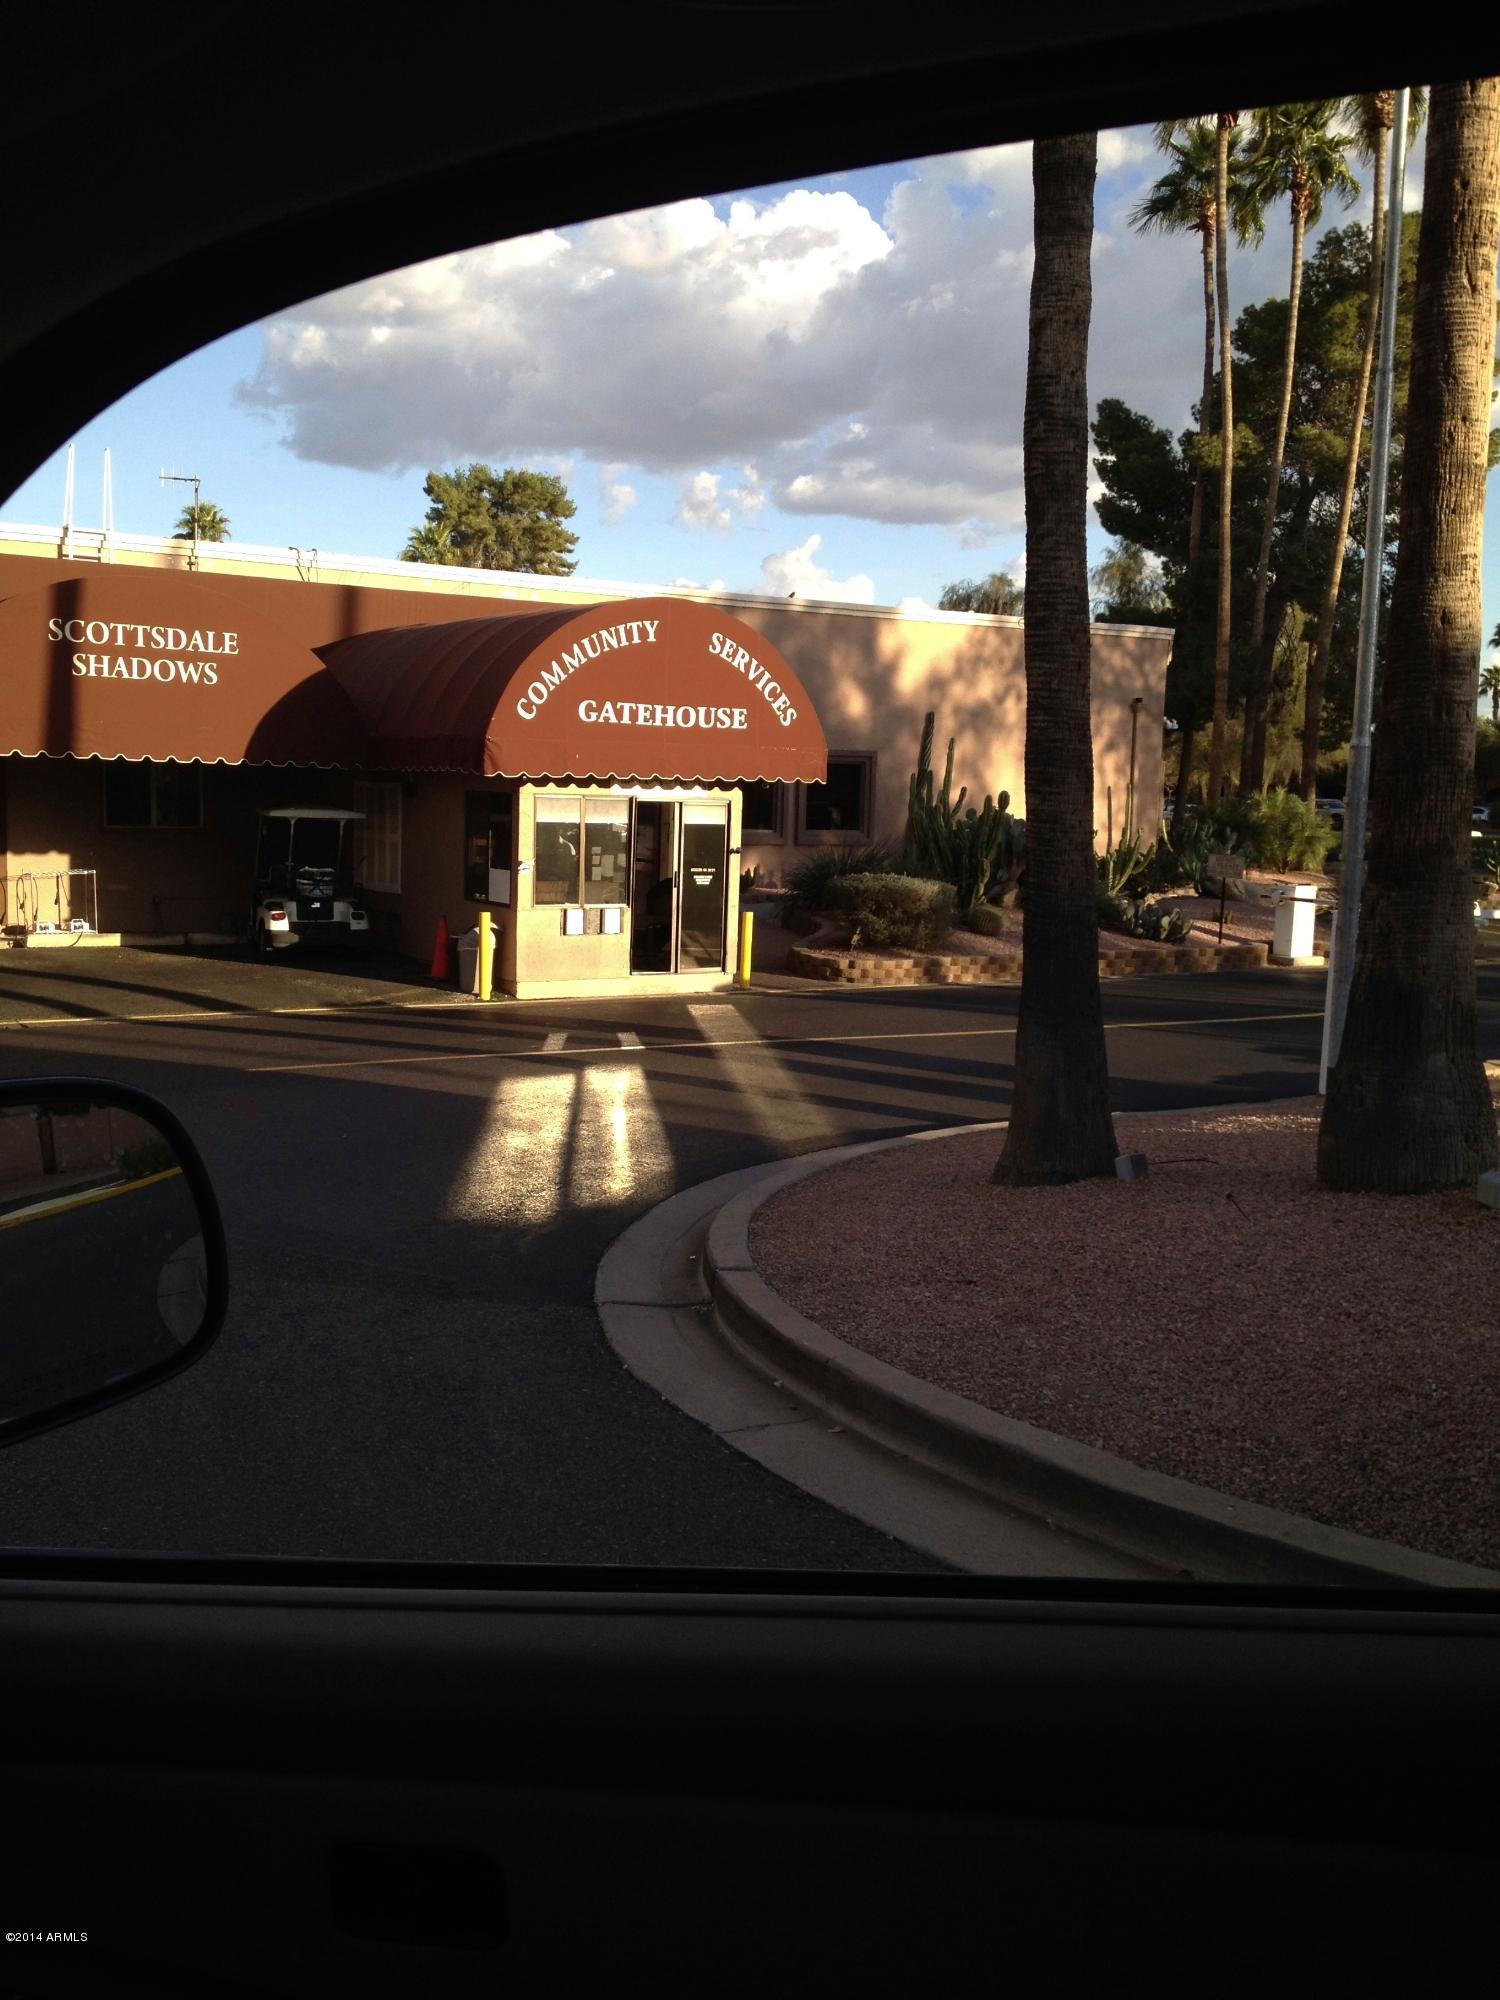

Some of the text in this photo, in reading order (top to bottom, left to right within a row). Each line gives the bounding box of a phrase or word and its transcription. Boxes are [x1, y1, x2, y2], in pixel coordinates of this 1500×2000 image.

[48, 618, 239, 655] SCOTTSDALE
[72, 653, 218, 685] SHADOWS
[516, 620, 797, 727] COMMUNITY SERVICES
[578, 700, 748, 730] GATEHOUSE
